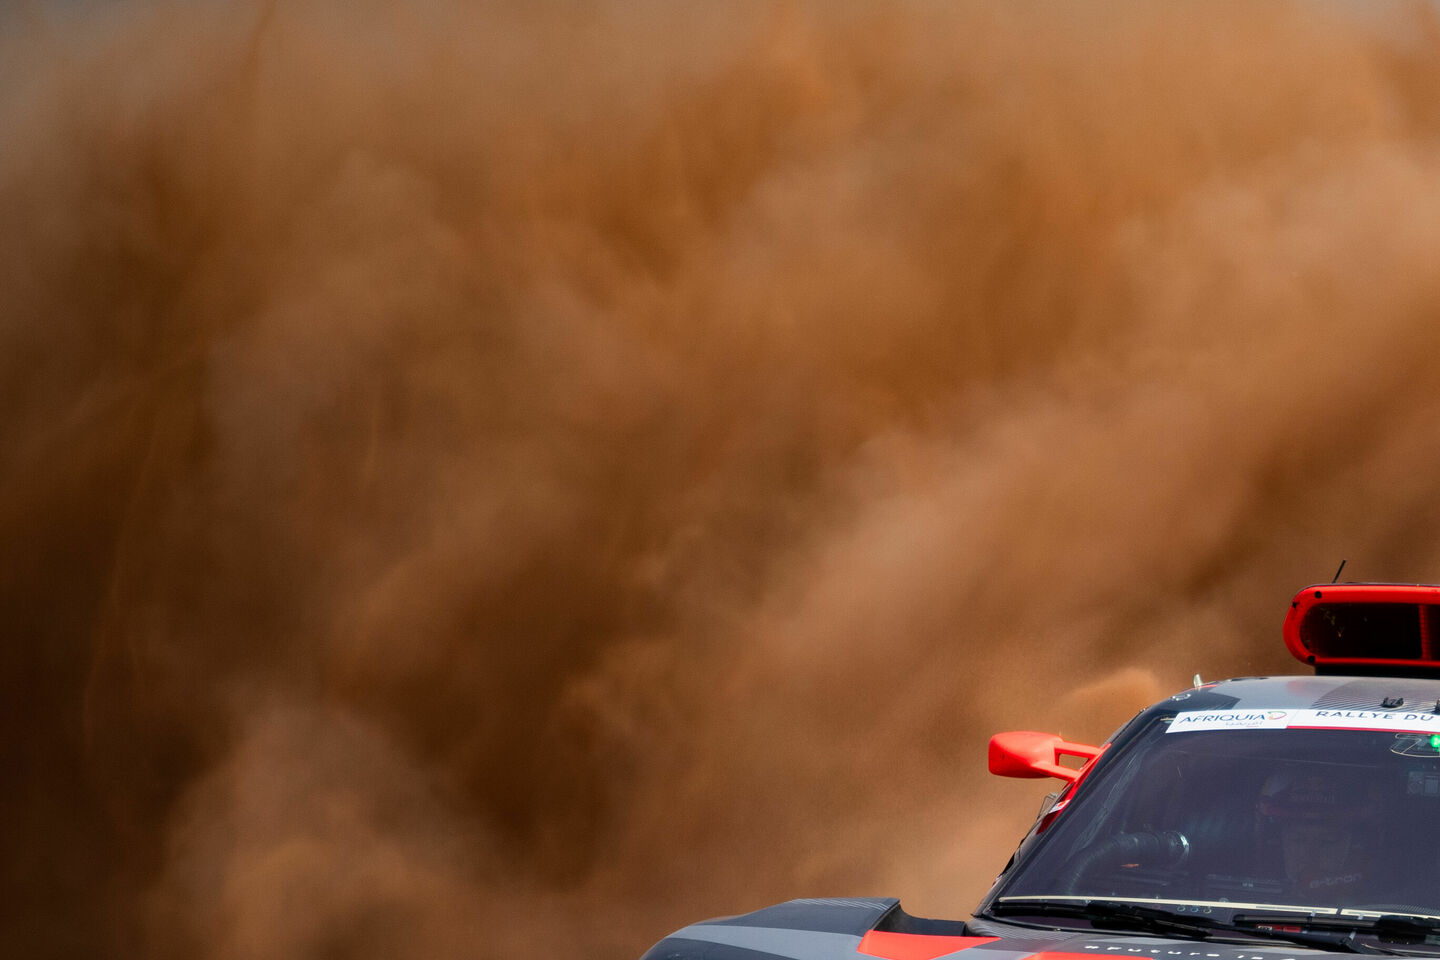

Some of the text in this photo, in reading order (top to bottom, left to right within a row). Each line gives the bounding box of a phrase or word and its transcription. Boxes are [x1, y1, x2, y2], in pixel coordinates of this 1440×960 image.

[1179, 712, 1265, 723] AFRIQUIA
[1315, 710, 1393, 720] RALLYE
[1404, 712, 1435, 722] DU
